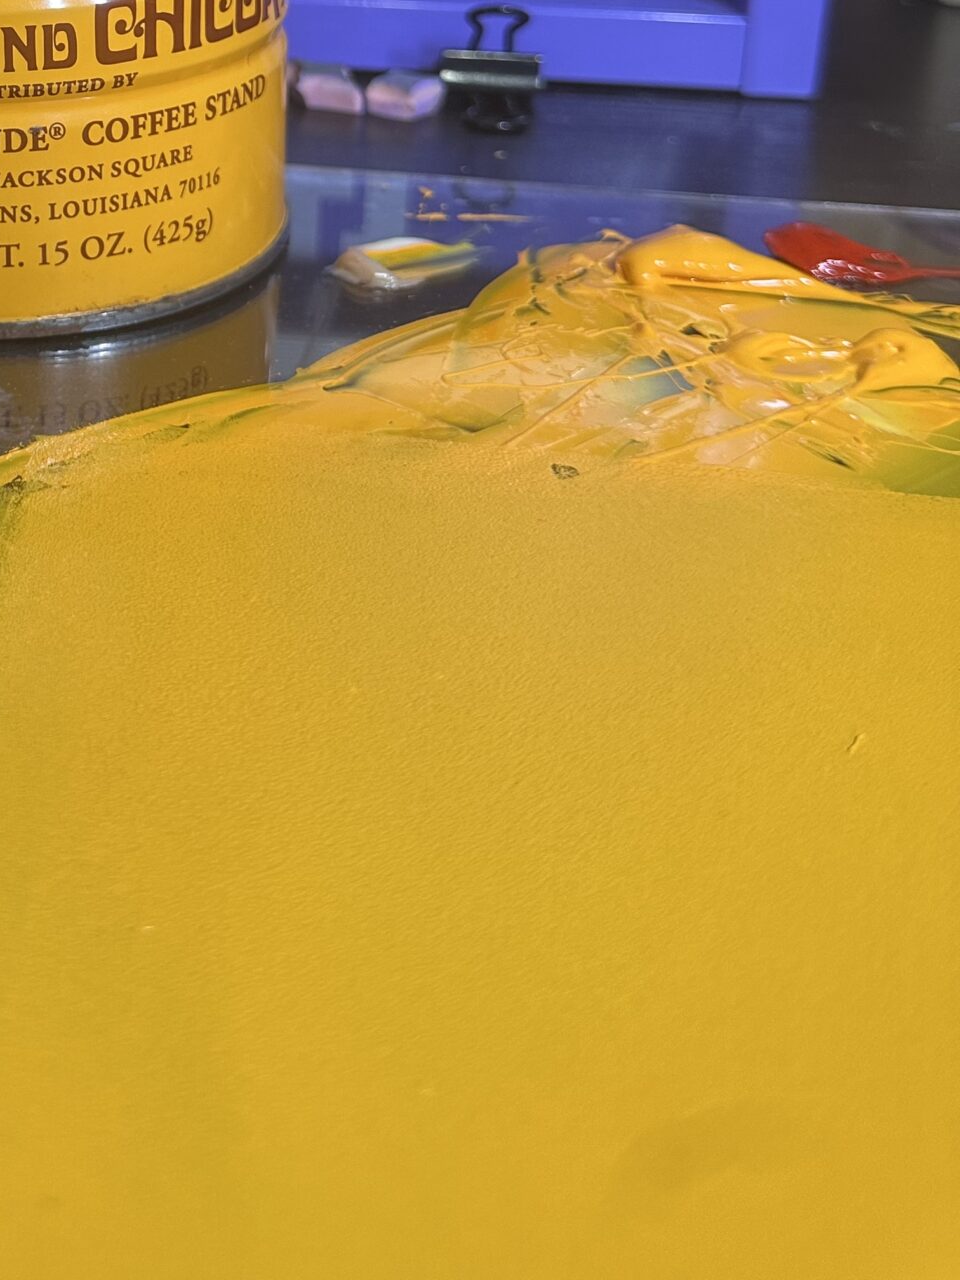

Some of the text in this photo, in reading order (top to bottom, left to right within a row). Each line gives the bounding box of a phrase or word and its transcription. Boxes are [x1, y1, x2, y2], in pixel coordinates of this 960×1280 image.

[112, 72, 139, 89] BY
[82, 102, 197, 146] COFFEE
[205, 73, 266, 121] STAND
[110, 145, 193, 178] SQUARE
[48, 184, 172, 221] LOUISIANA
[179, 167, 221, 198] 70116
[38, 240, 69, 267] 15
[80, 231, 133, 260] OZ.
[143, 207, 213, 253] (425g)
